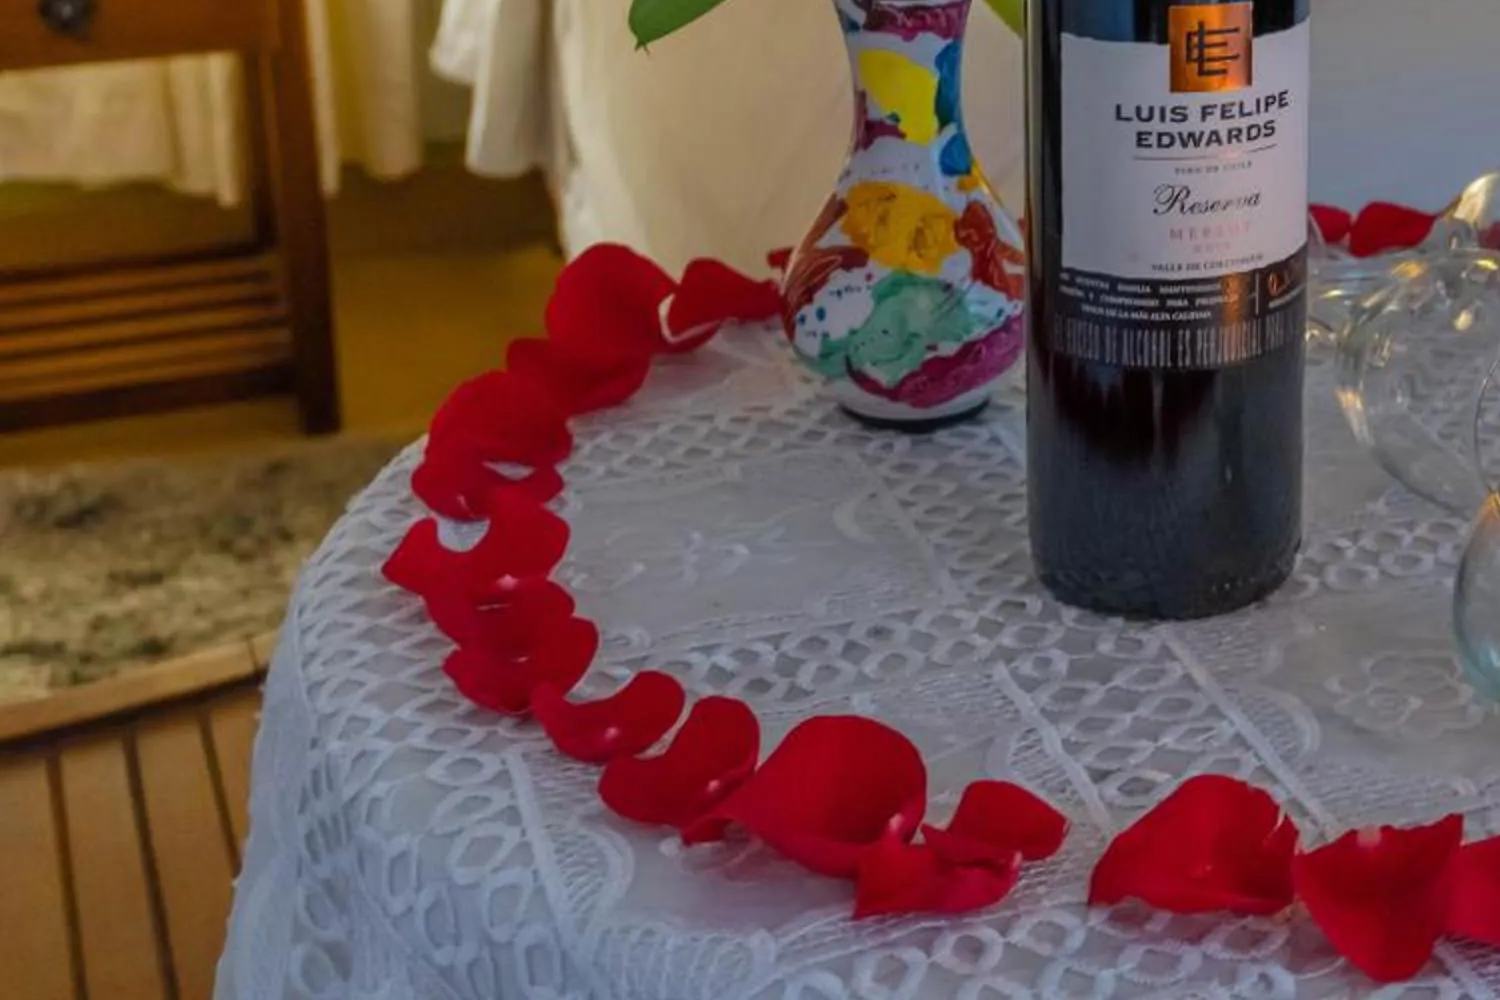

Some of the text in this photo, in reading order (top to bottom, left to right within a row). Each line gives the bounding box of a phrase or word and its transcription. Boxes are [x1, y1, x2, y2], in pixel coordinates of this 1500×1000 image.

[1115, 90, 1290, 124] LUIS FELIPE
[1135, 119, 1277, 150] EDWARDS
[1152, 183, 1261, 216] Reserva
